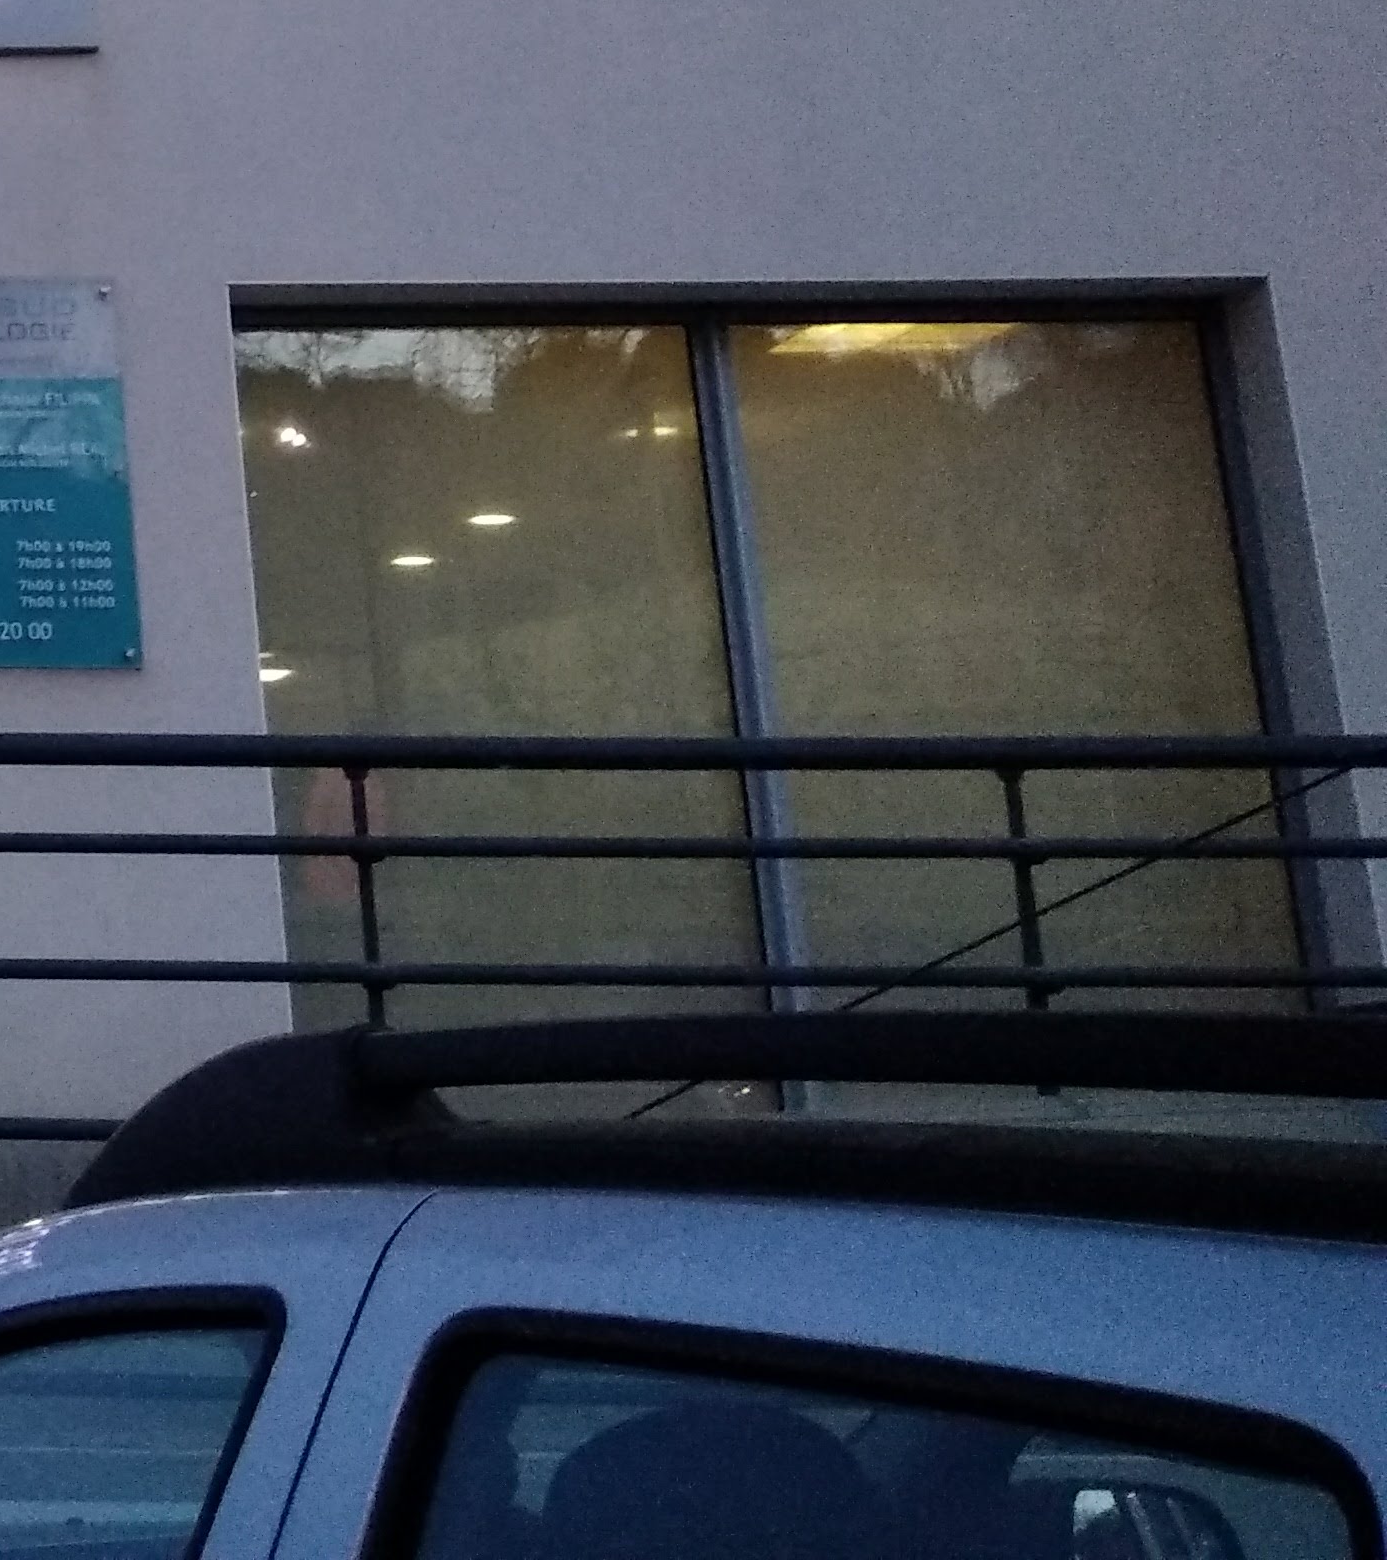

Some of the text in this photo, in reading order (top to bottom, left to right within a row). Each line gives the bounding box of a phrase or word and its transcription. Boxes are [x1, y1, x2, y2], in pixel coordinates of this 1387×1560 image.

[16, 540, 51, 552] 7h00
[68, 540, 112, 552] 19h00
[18, 557, 52, 569] 7h00
[70, 557, 112, 569] 18h00
[18, 579, 54, 592] 7h00
[72, 579, 114, 592] 12h00
[20, 596, 55, 608] 7h00
[73, 596, 116, 608] 11h00
[0, 622, 23, 640] 20
[28, 622, 53, 640] 00
